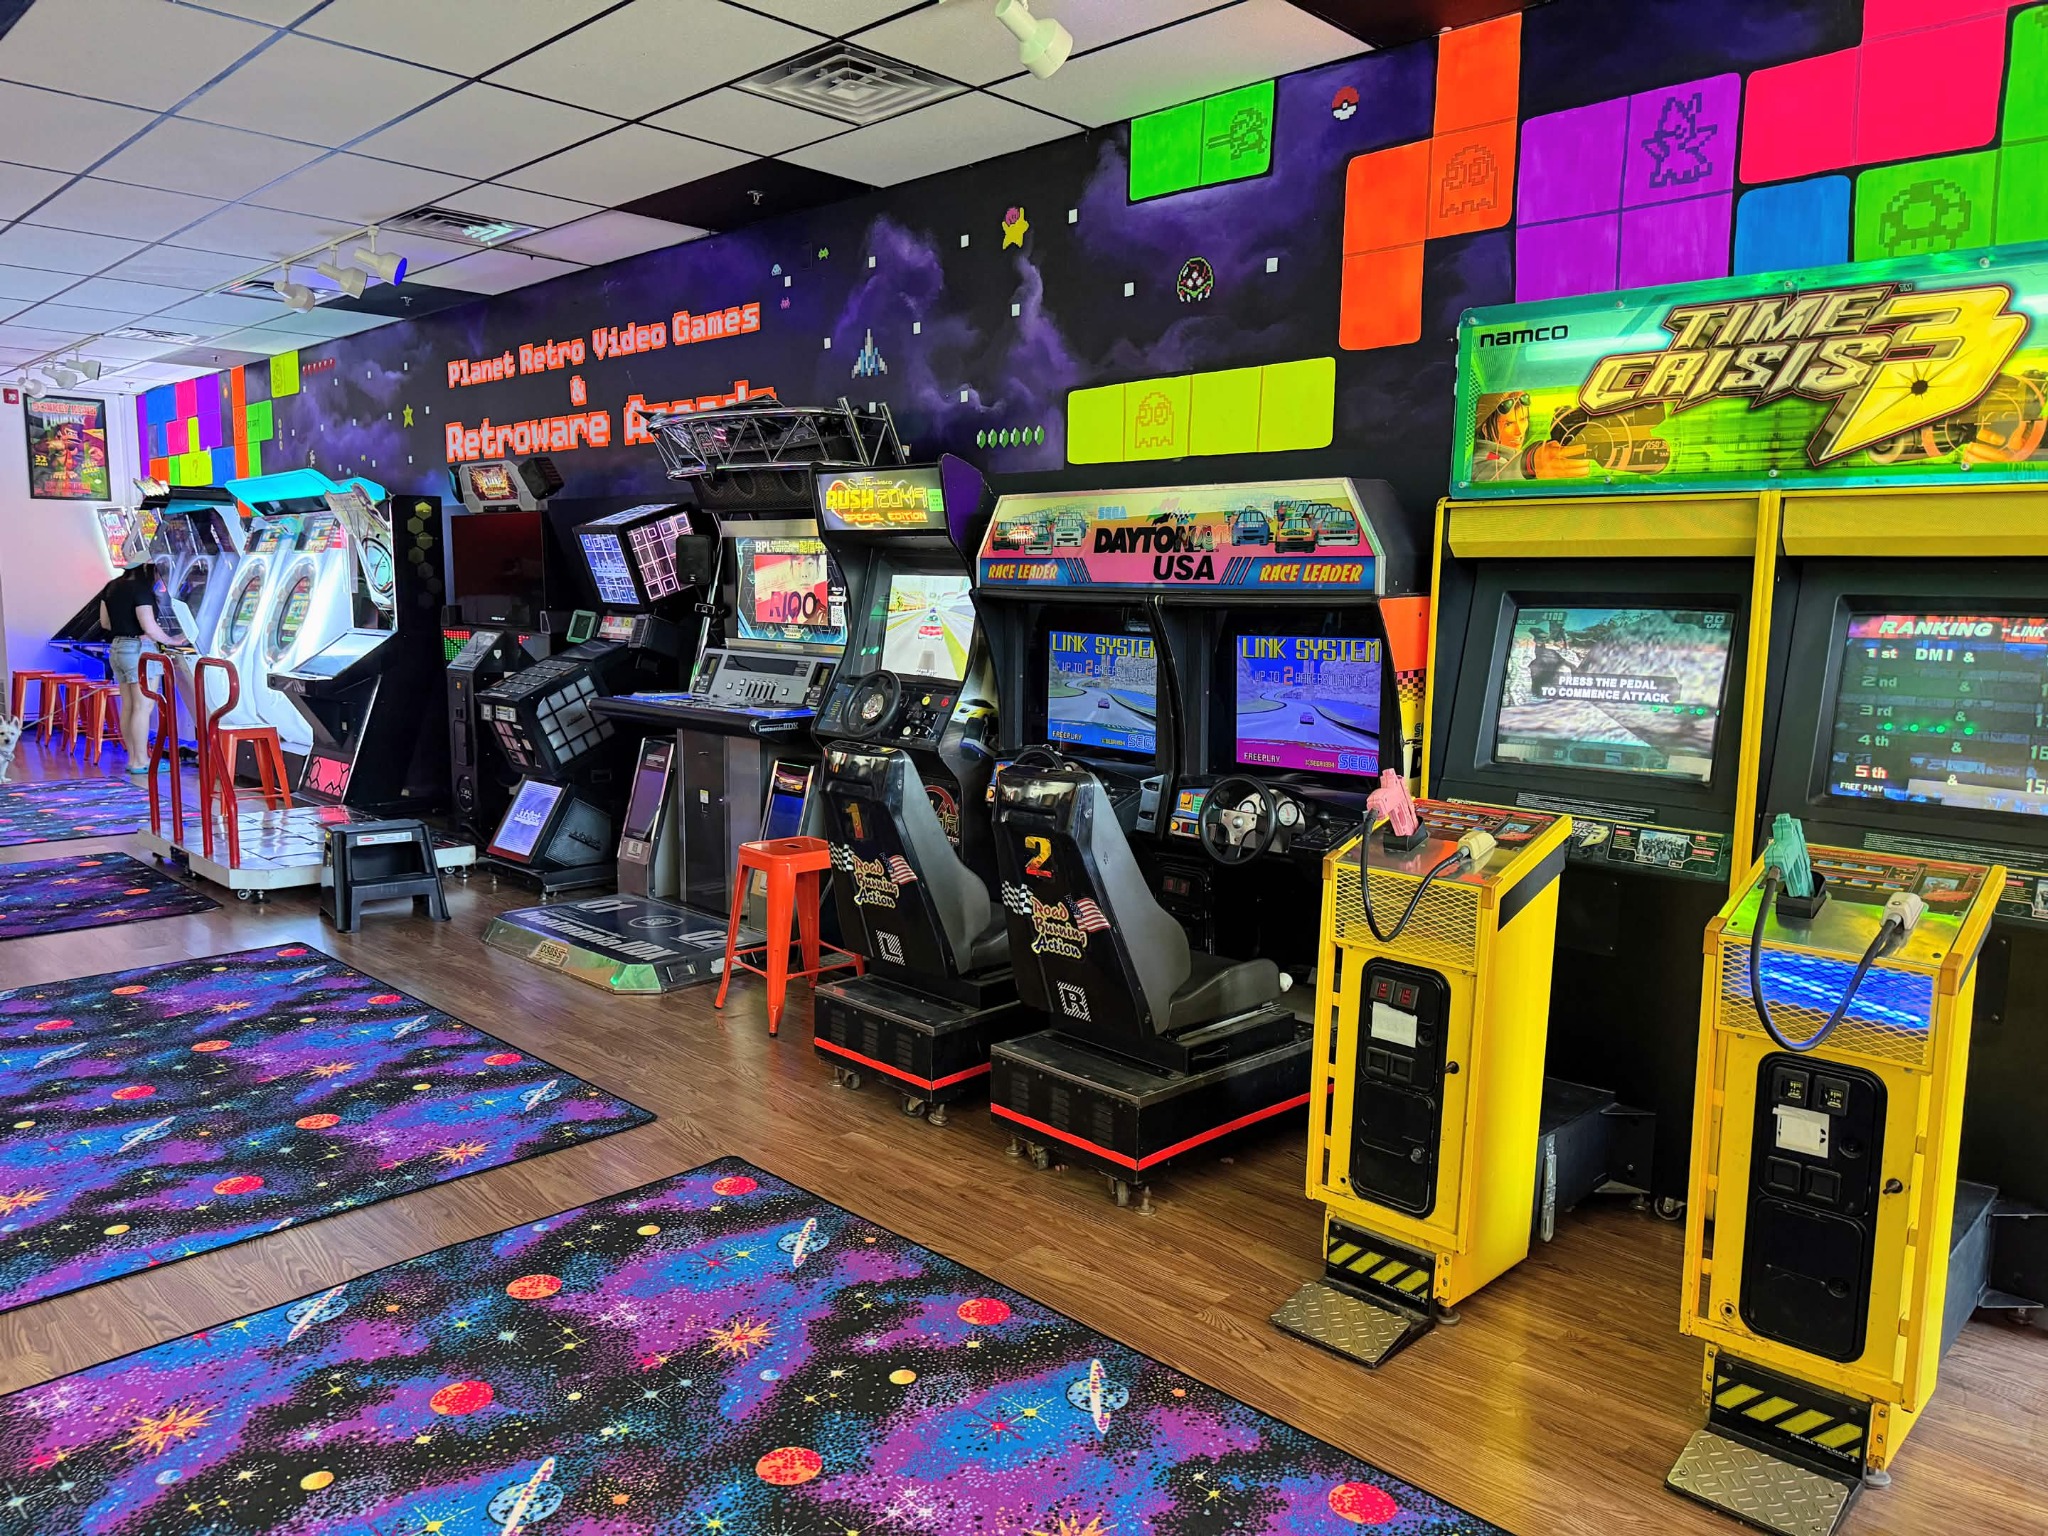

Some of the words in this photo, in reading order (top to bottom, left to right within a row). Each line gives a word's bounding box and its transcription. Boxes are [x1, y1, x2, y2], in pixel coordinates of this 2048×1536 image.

[1671, 288, 1892, 351] TIME
[448, 351, 516, 388] Planet
[519, 338, 585, 375] Retro
[592, 322, 667, 360] Video
[672, 302, 760, 346] Games
[1479, 323, 1570, 349] namco
[1581, 334, 1894, 412] CRISIS
[1808, 284, 2031, 466] 3
[570, 375, 587, 406] &
[445, 410, 610, 463] Retroware
[826, 488, 875, 509] RUSH
[887, 510, 928, 522] EDITION
[1098, 506, 1127, 520] SEGA
[988, 564, 1015, 580] RACE
[1017, 563, 1059, 580] LEADER
[1153, 556, 1215, 581] USA
[1259, 563, 1301, 583] RACE
[1302, 562, 1364, 584] LEADER
[1879, 621, 1994, 637] RANKING
[1052, 634, 1088, 653] LINK
[1242, 638, 1287, 659] LINK
[1296, 639, 1380, 663] SYSTEM
[1062, 661, 1071, 672] UP
[1073, 663, 1082, 673] TO
[1085, 659, 1093, 676] 2
[1963, 652, 1975, 663] &
[1254, 670, 1265, 682] UP
[1269, 671, 1280, 682] TO
[1283, 666, 1293, 686] 2
[1558, 675, 1594, 688] PRESS
[1595, 677, 1617, 688] THE
[1619, 678, 1657, 690] PEDAL
[1541, 686, 1557, 697] TO
[1558, 687, 1620, 700] COMMENCE
[1622, 691, 1670, 703] ATTACK
[1337, 751, 1379, 773] SEGA
[1840, 782, 1859, 790] FREE
[1863, 783, 1884, 793] PLAY
[1946, 774, 1957, 786] &
[843, 803, 864, 839] 1
[1025, 836, 1052, 878] 2
[854, 888, 896, 908] Action
[515, 910, 623, 948] beatmania
[1031, 934, 1082, 959] Action
